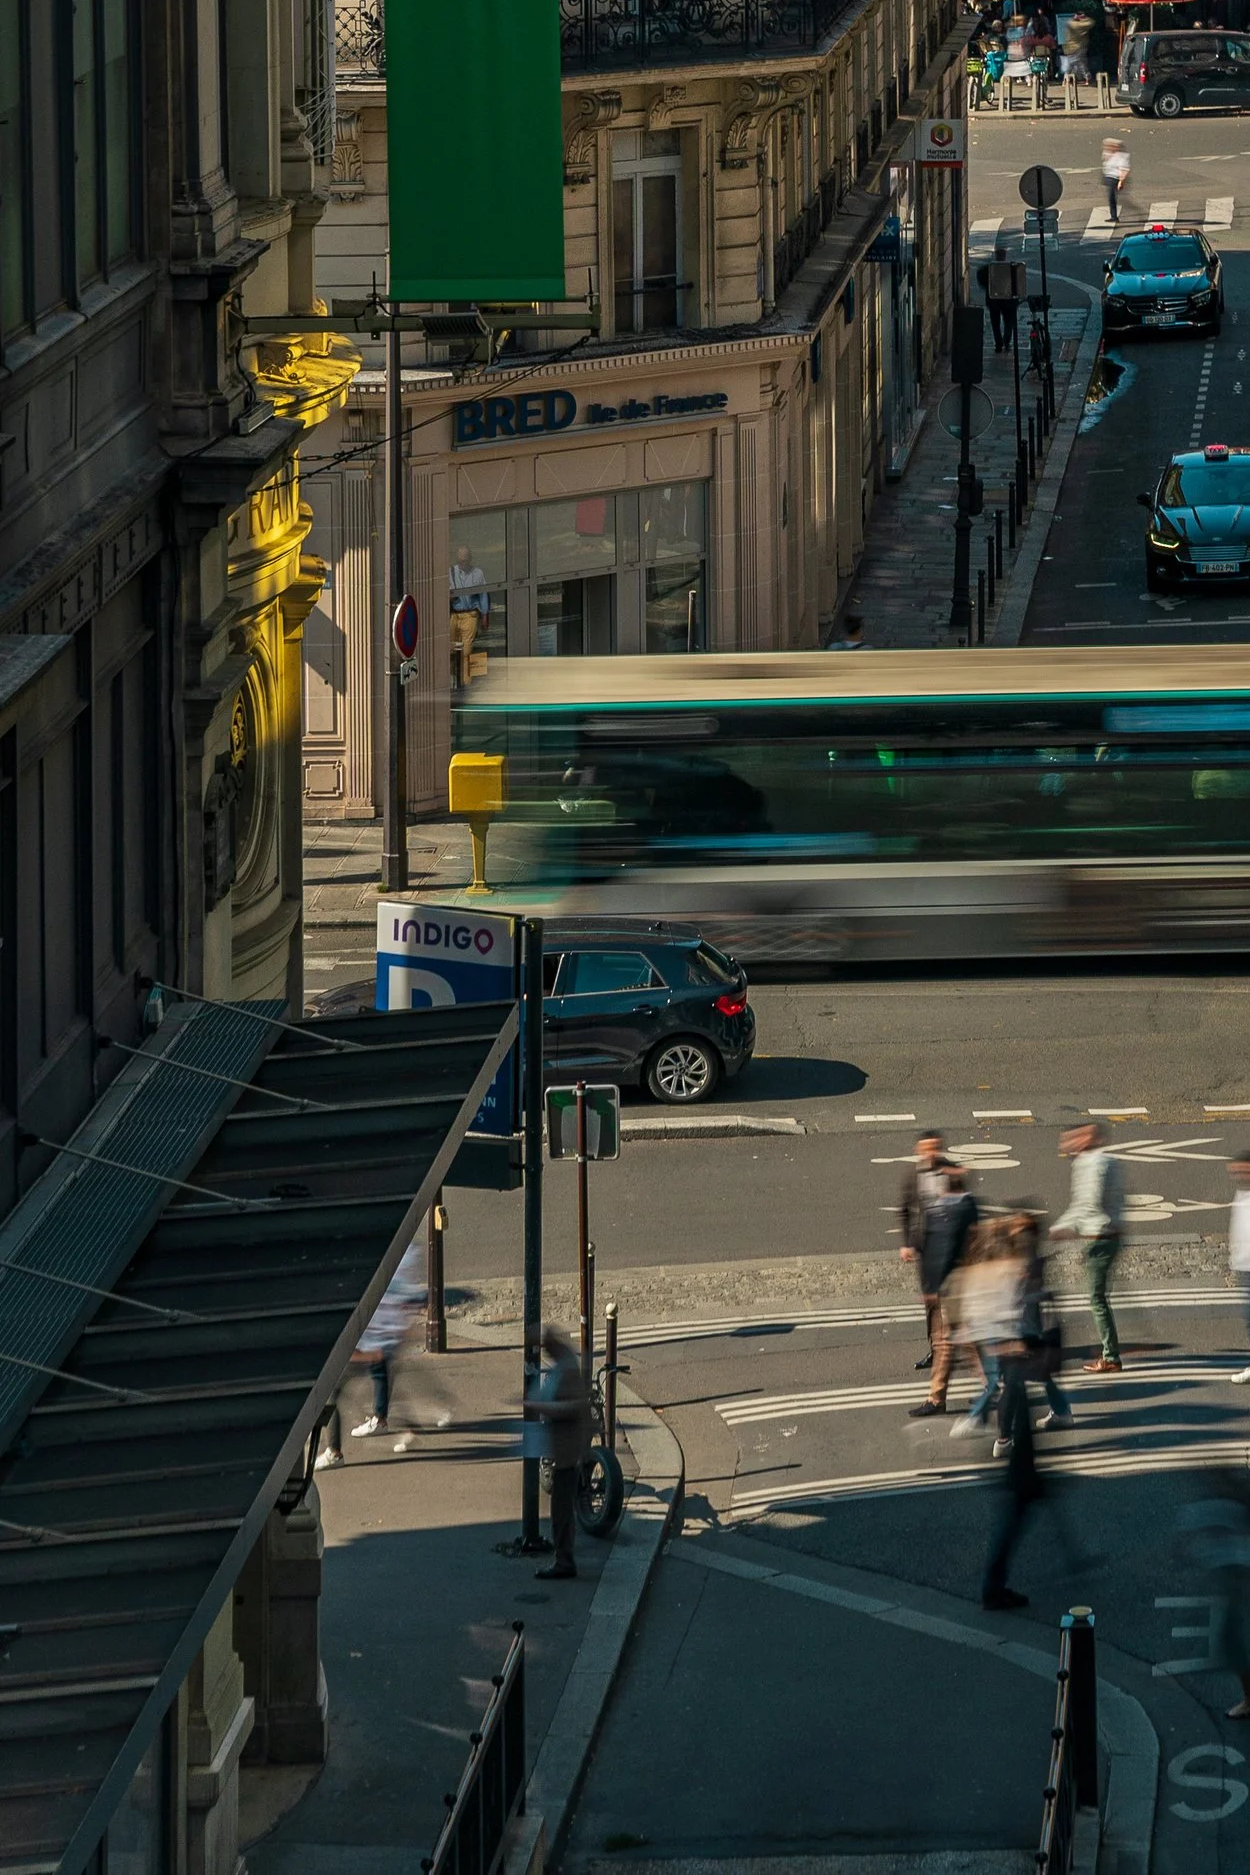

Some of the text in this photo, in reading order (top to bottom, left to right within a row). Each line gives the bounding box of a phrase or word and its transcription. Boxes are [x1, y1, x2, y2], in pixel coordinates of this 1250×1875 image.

[456, 390, 577, 442] BRED
[620, 399, 651, 421] de
[654, 392, 729, 415] France
[393, 918, 494, 955] INDIGO
